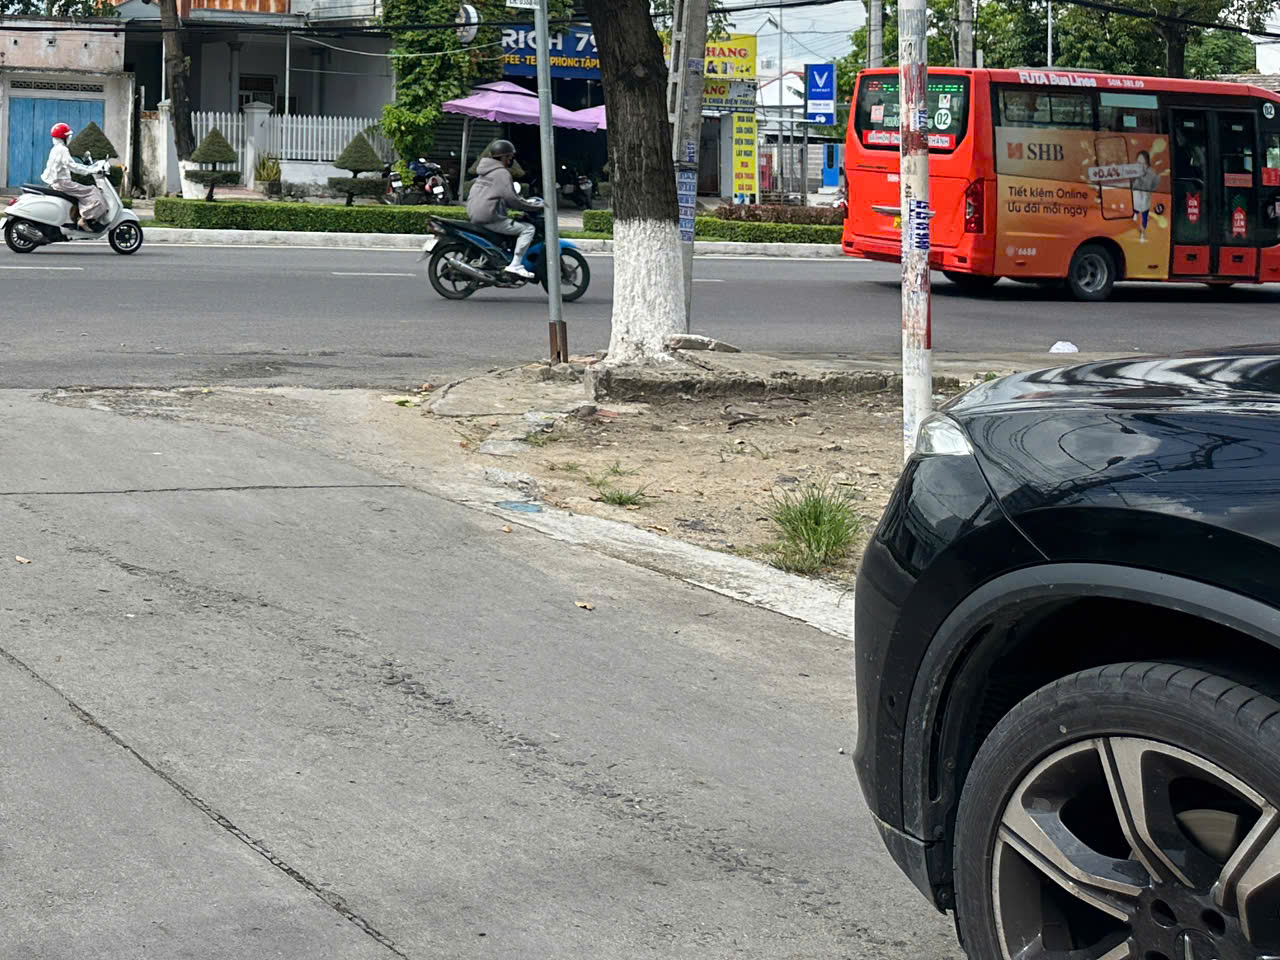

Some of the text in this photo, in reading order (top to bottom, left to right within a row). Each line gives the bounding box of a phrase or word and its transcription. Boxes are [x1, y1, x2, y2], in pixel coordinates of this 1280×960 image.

[525, 55, 537, 65] TE
[1019, 71, 1097, 87] FUTA Bus Lines
[936, 112, 949, 126] 02
[1027, 143, 1064, 161] SHB
[1008, 186, 1088, 201] Tiết kiệm Online
